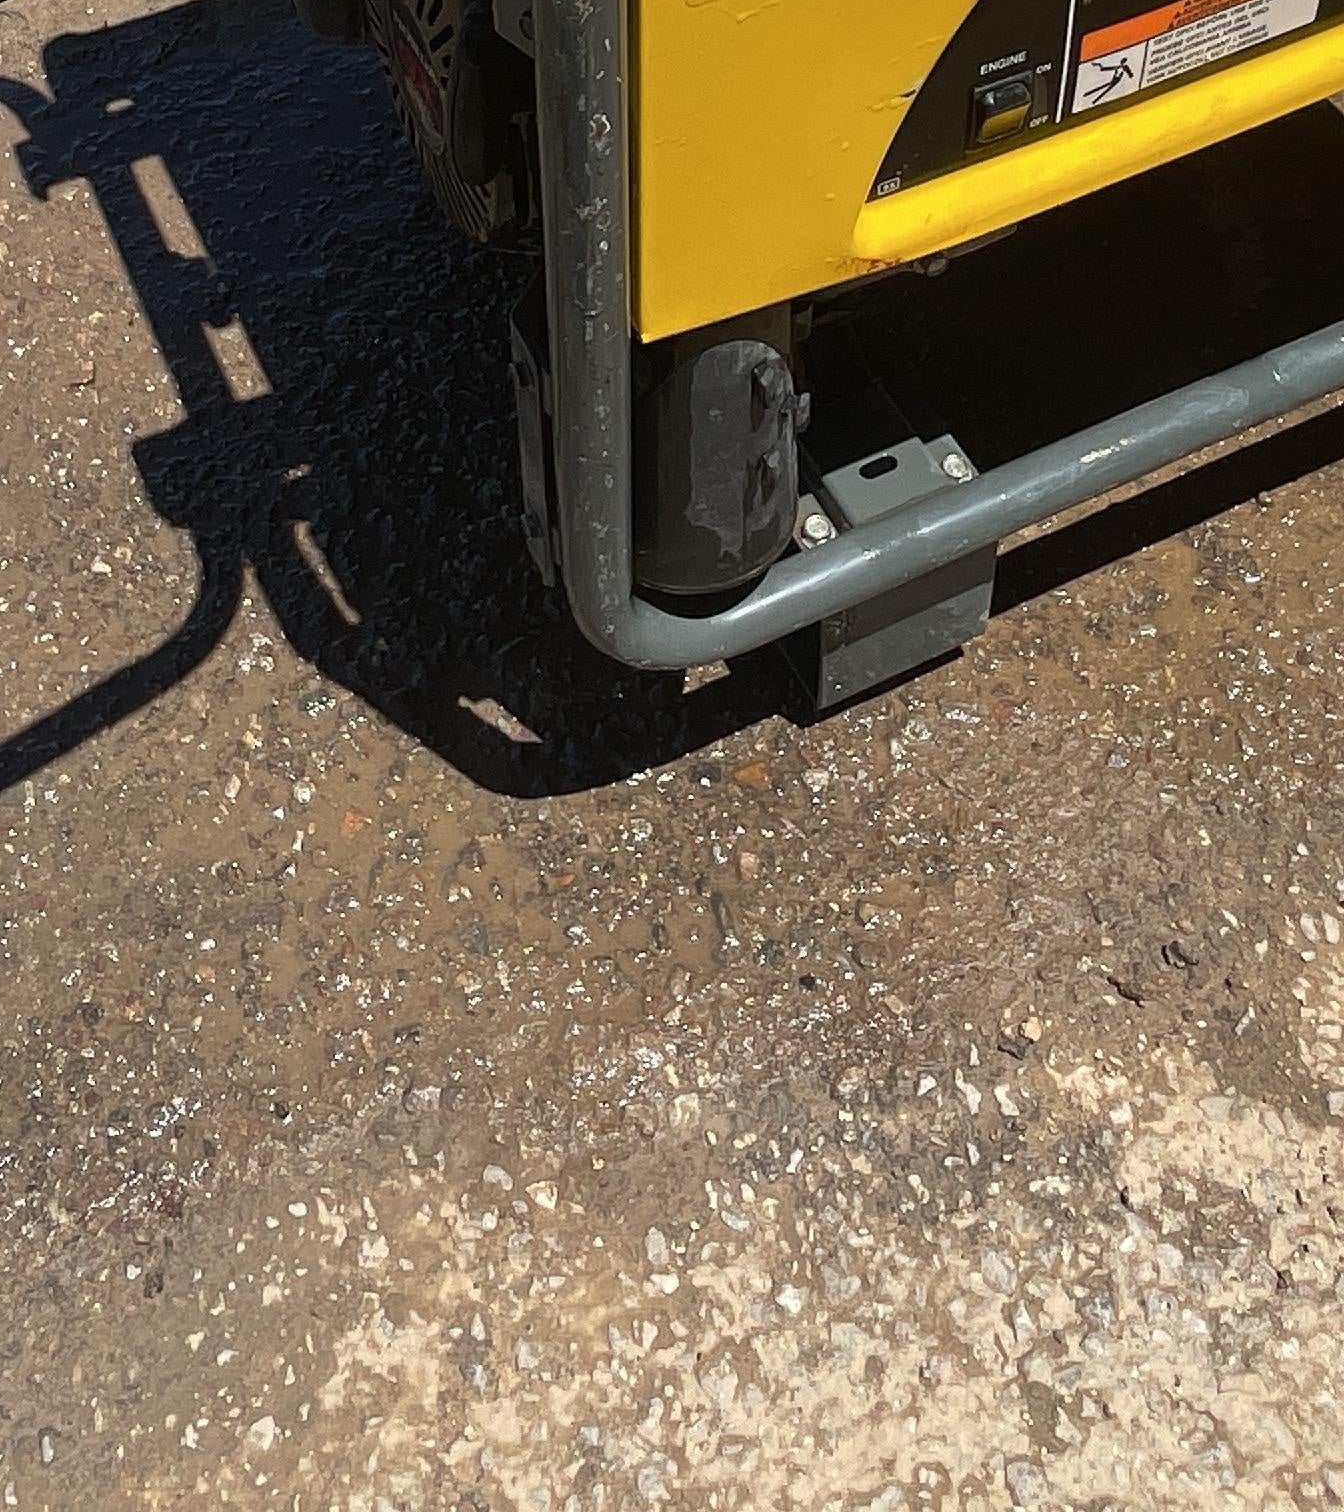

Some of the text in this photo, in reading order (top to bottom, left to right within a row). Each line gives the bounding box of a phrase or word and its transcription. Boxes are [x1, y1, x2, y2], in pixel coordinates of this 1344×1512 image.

[980, 50, 1028, 75] ENGINE
[1036, 62, 1052, 74] ON
[1029, 115, 1049, 128] OFF
